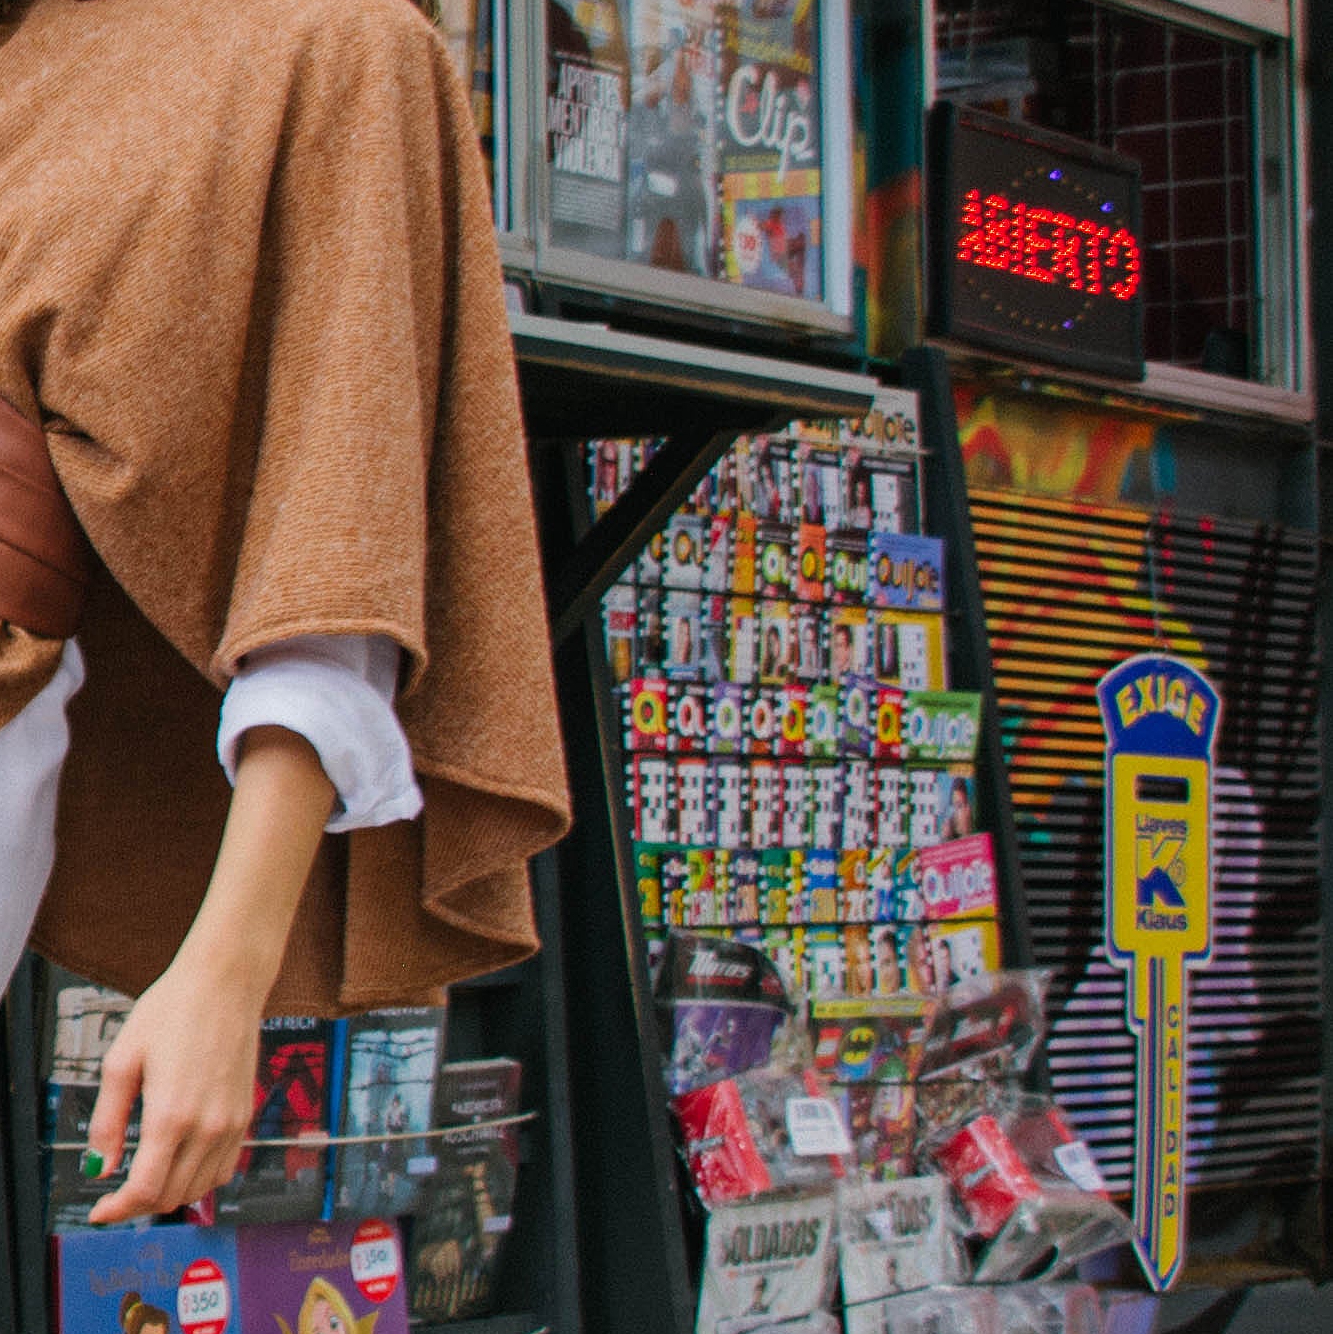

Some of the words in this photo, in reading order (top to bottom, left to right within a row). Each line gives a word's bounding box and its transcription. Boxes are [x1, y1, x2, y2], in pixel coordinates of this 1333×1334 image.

[727, 66, 816, 182] Clip
[957, 188, 1141, 300] ABIERTO
[1115, 674, 1207, 739] EXIGE
[1135, 908, 1188, 932] Klaus
[1162, 1004, 1182, 1219] CALIDAD
